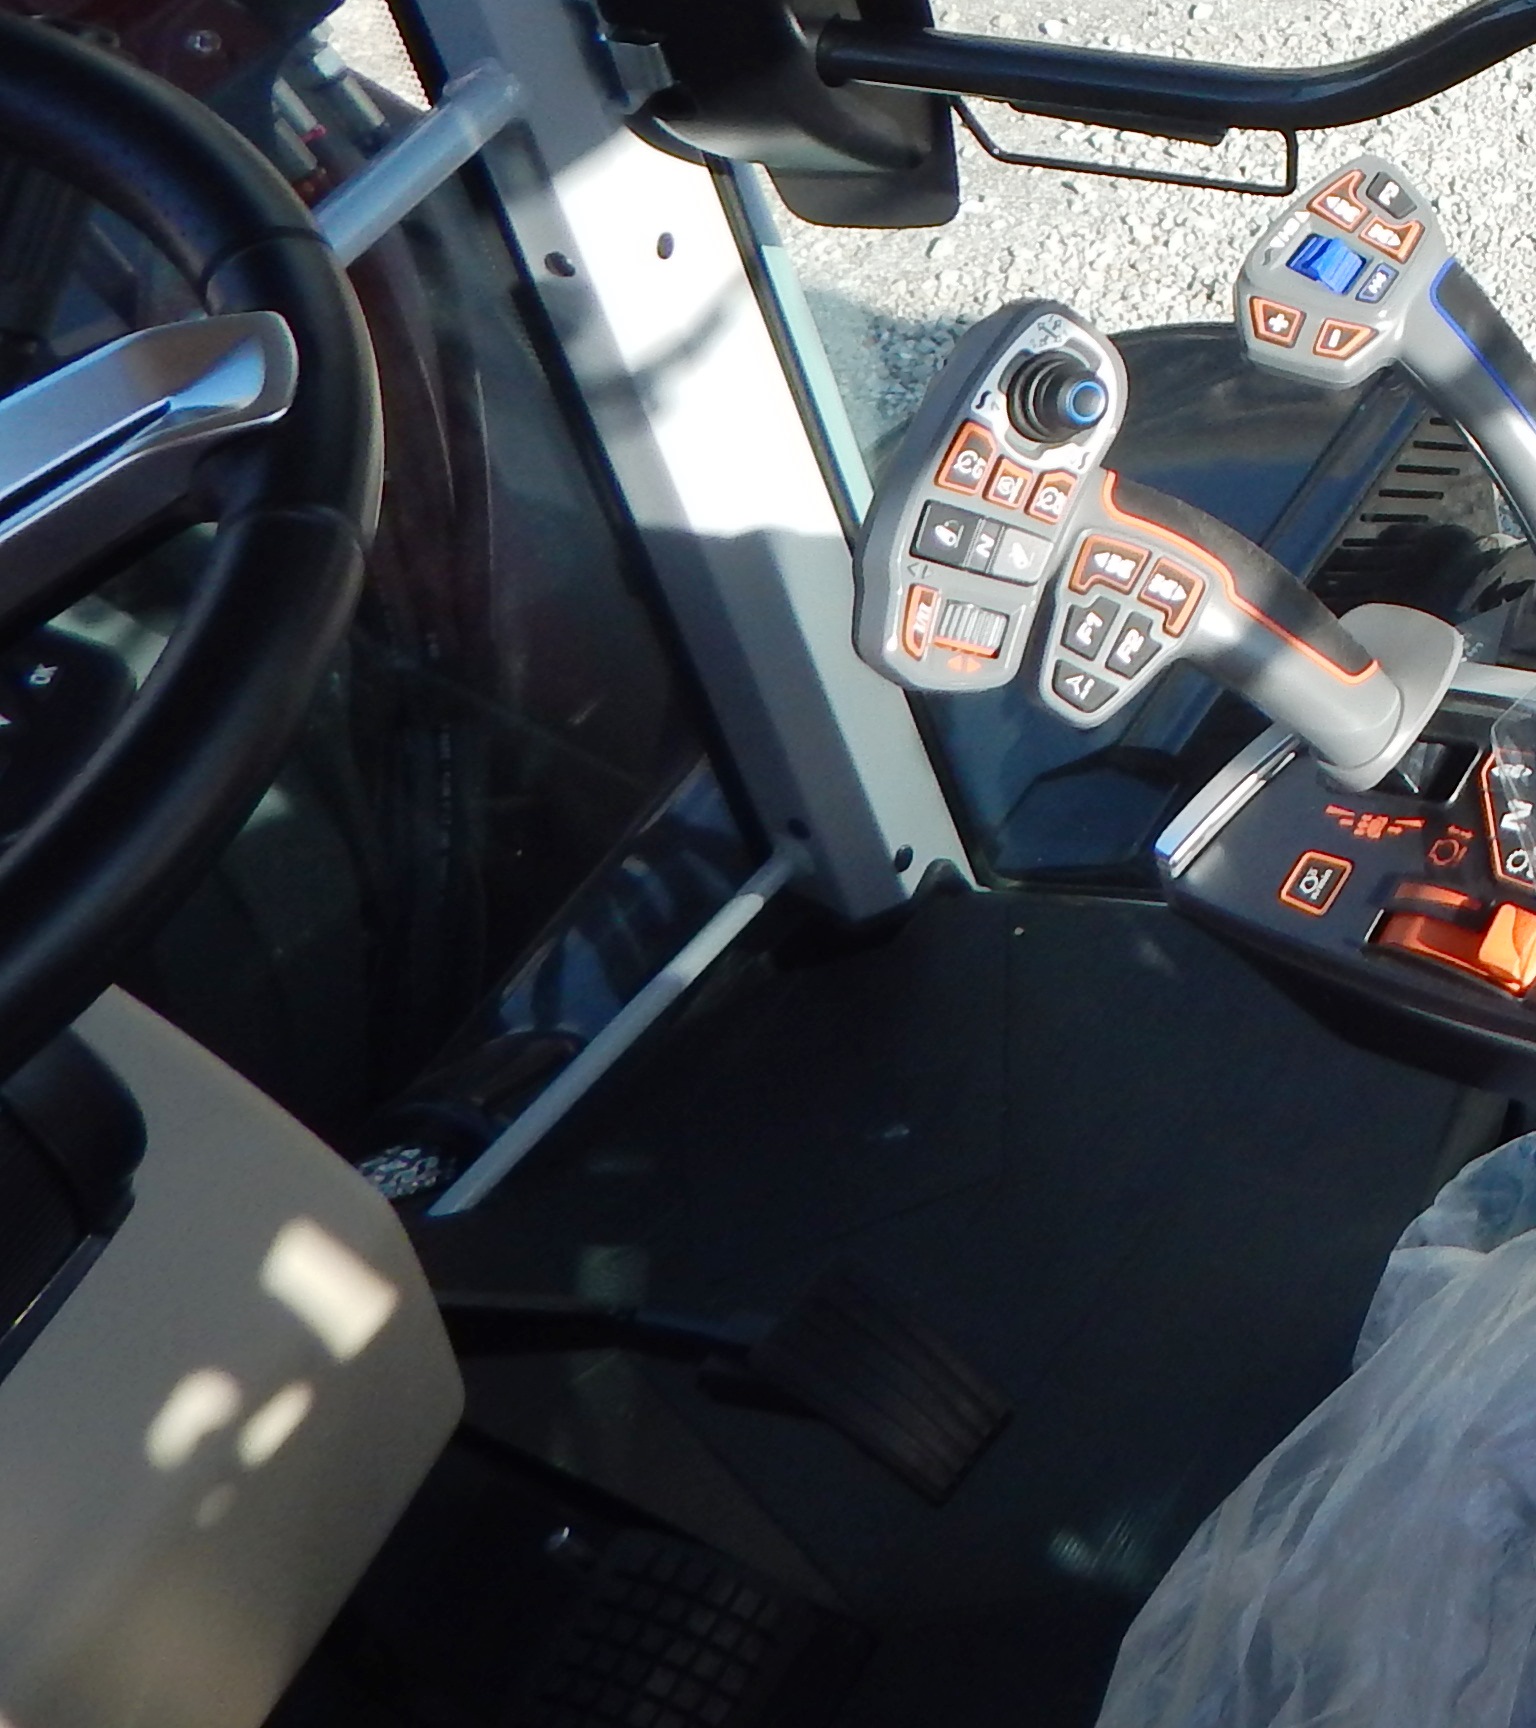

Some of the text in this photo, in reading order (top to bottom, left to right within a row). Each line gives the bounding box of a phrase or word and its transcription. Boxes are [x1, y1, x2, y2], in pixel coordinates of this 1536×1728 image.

[975, 533, 995, 558] N
[1077, 611, 1103, 645] F1
[1115, 628, 1144, 664] F2
